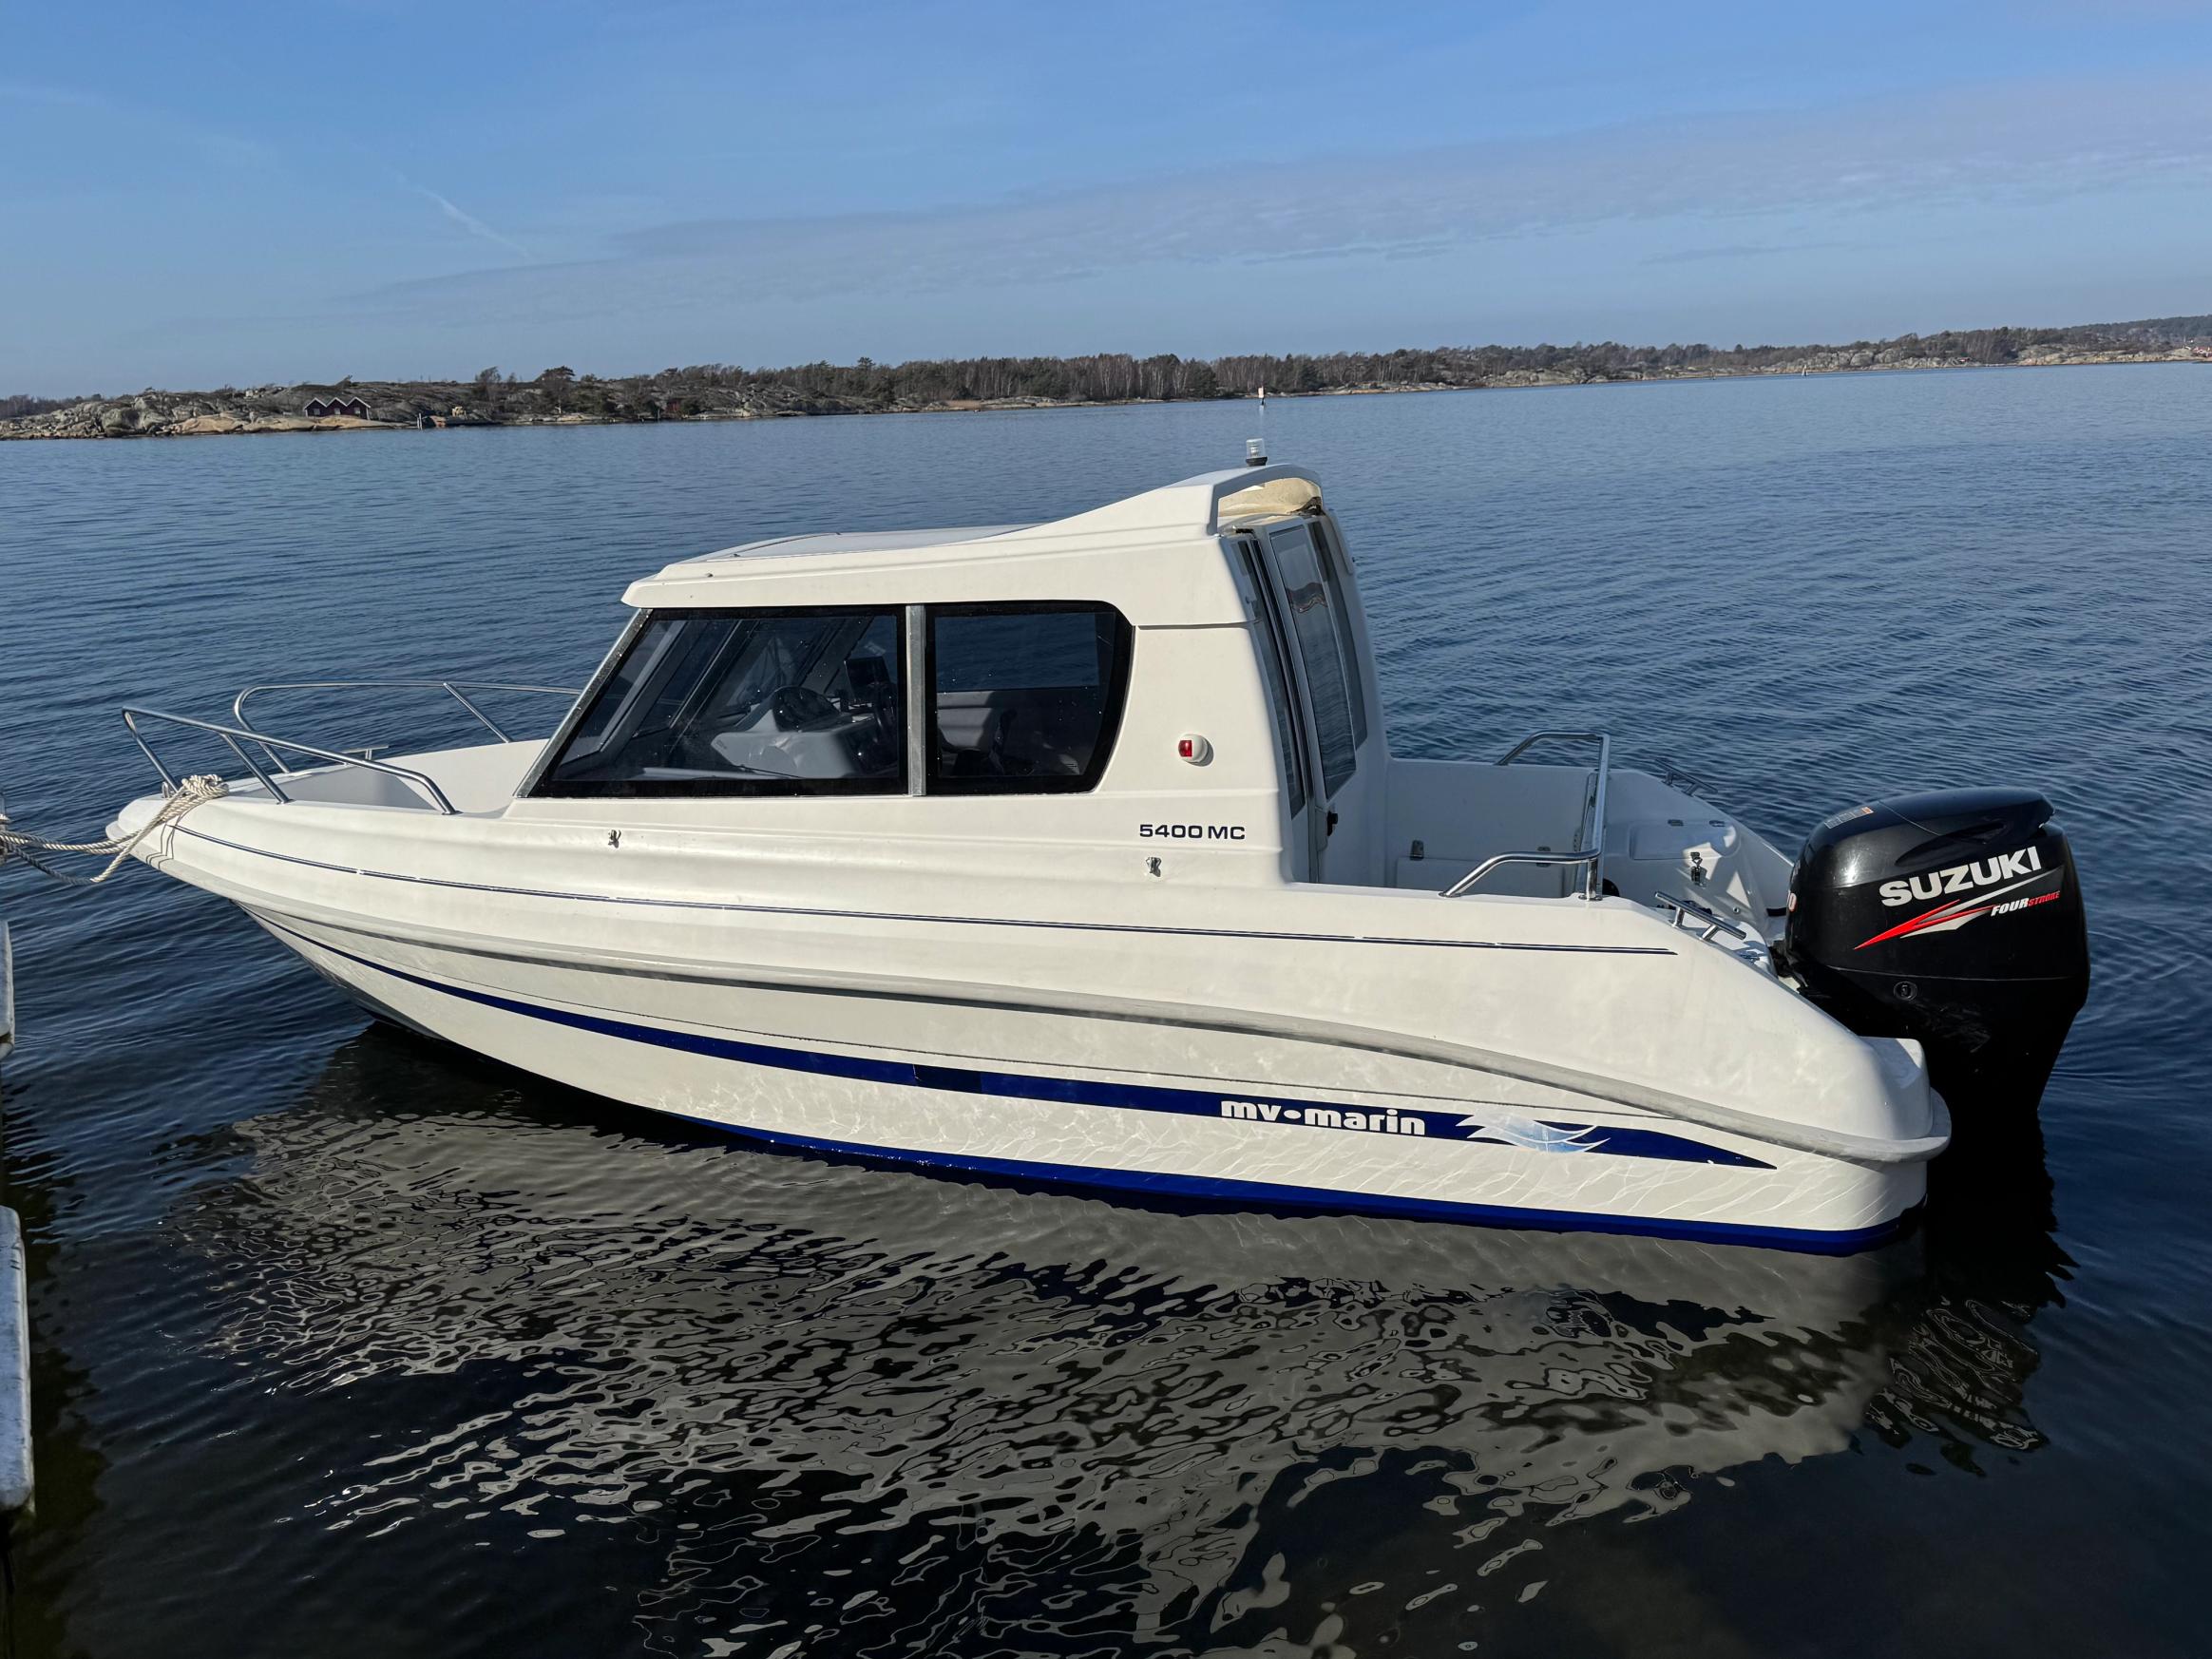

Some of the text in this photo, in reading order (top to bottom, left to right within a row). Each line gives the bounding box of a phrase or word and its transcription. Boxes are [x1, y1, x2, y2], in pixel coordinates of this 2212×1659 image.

[1139, 824, 1246, 840] 5400 MC
[1878, 846, 2042, 906] SUZUKI
